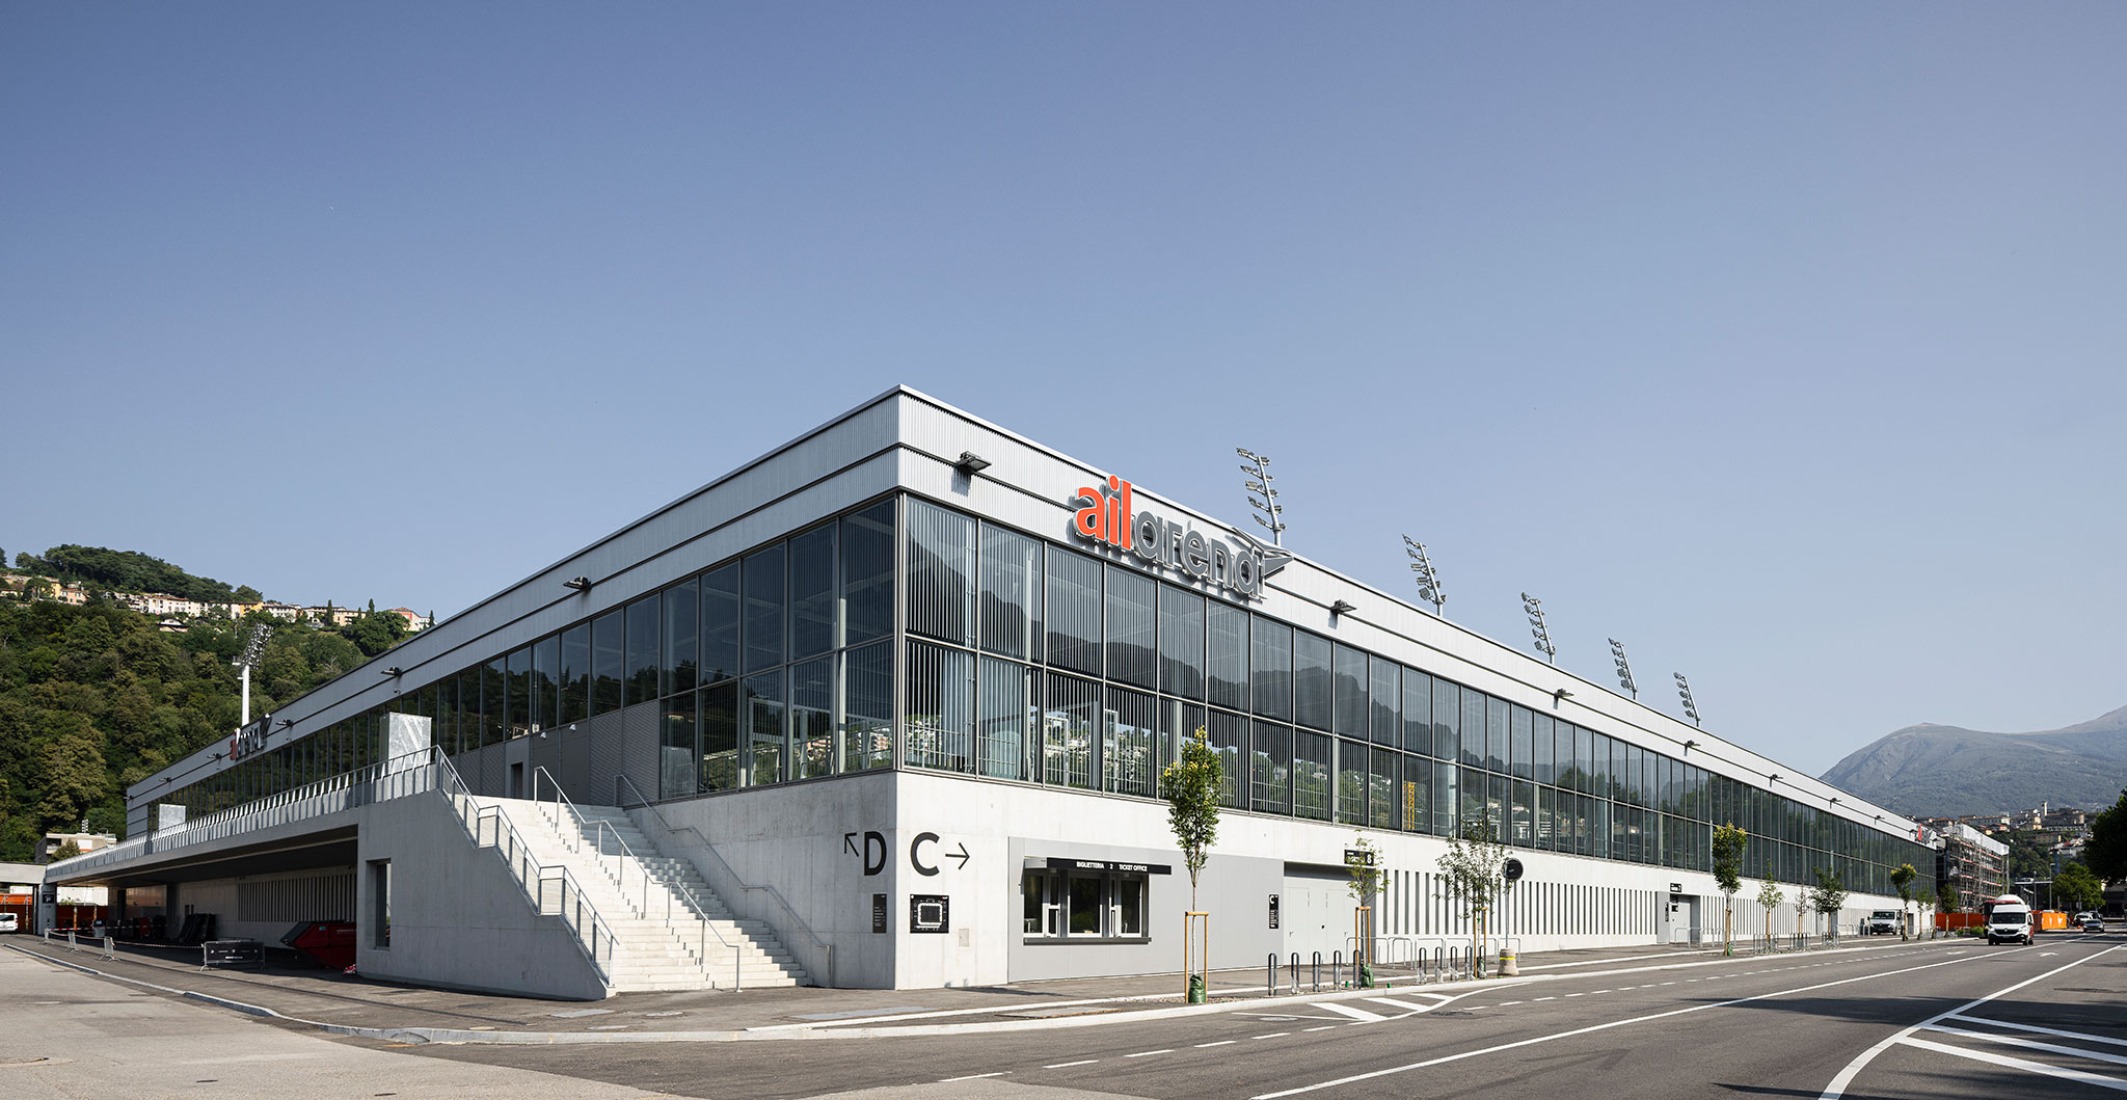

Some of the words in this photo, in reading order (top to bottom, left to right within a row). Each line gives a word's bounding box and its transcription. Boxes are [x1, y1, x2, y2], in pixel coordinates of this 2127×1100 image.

[863, 831, 887, 876] D
[910, 831, 940, 877] C
[1367, 854, 1372, 864] 8
